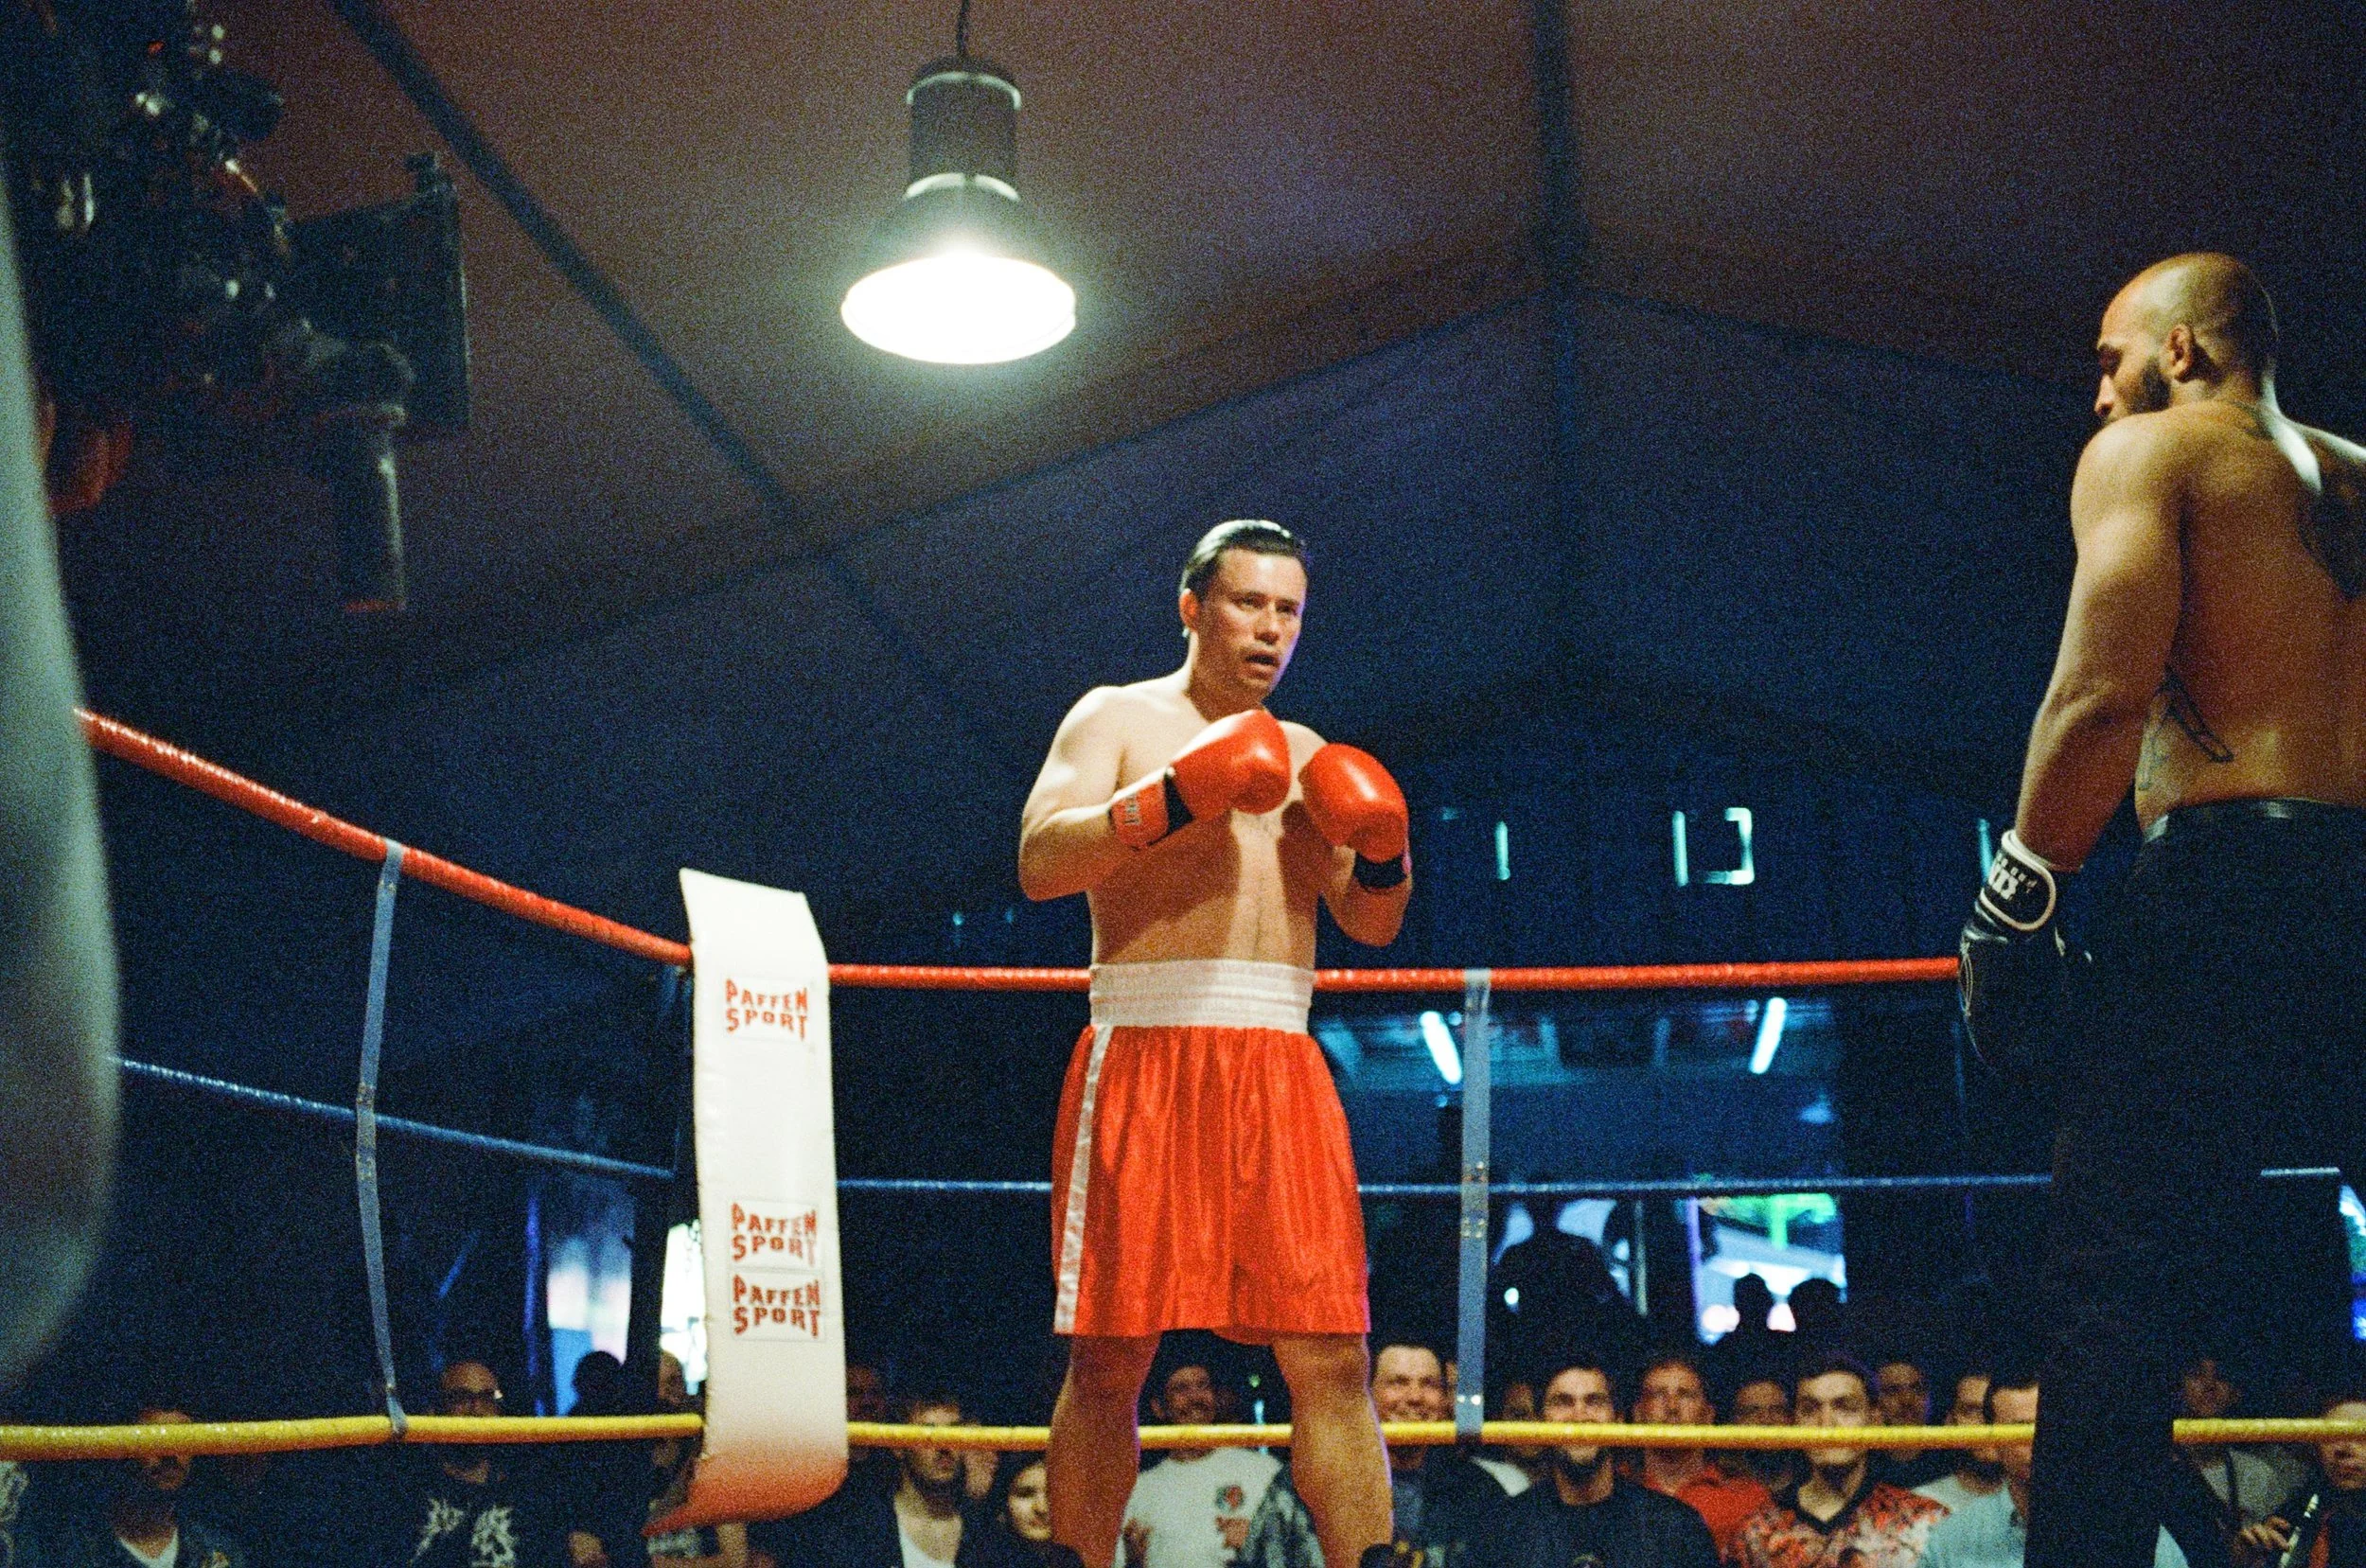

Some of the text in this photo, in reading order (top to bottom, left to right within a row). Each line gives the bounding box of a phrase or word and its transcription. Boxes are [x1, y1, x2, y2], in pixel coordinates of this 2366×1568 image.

[725, 978, 808, 1013] PAFFEN
[725, 1008, 808, 1042] SPORT
[731, 1203, 817, 1239] PAFFEN
[732, 1234, 816, 1268] SPORT
[733, 1274, 821, 1307] PAFFEN
[733, 1306, 821, 1339] SPORT
